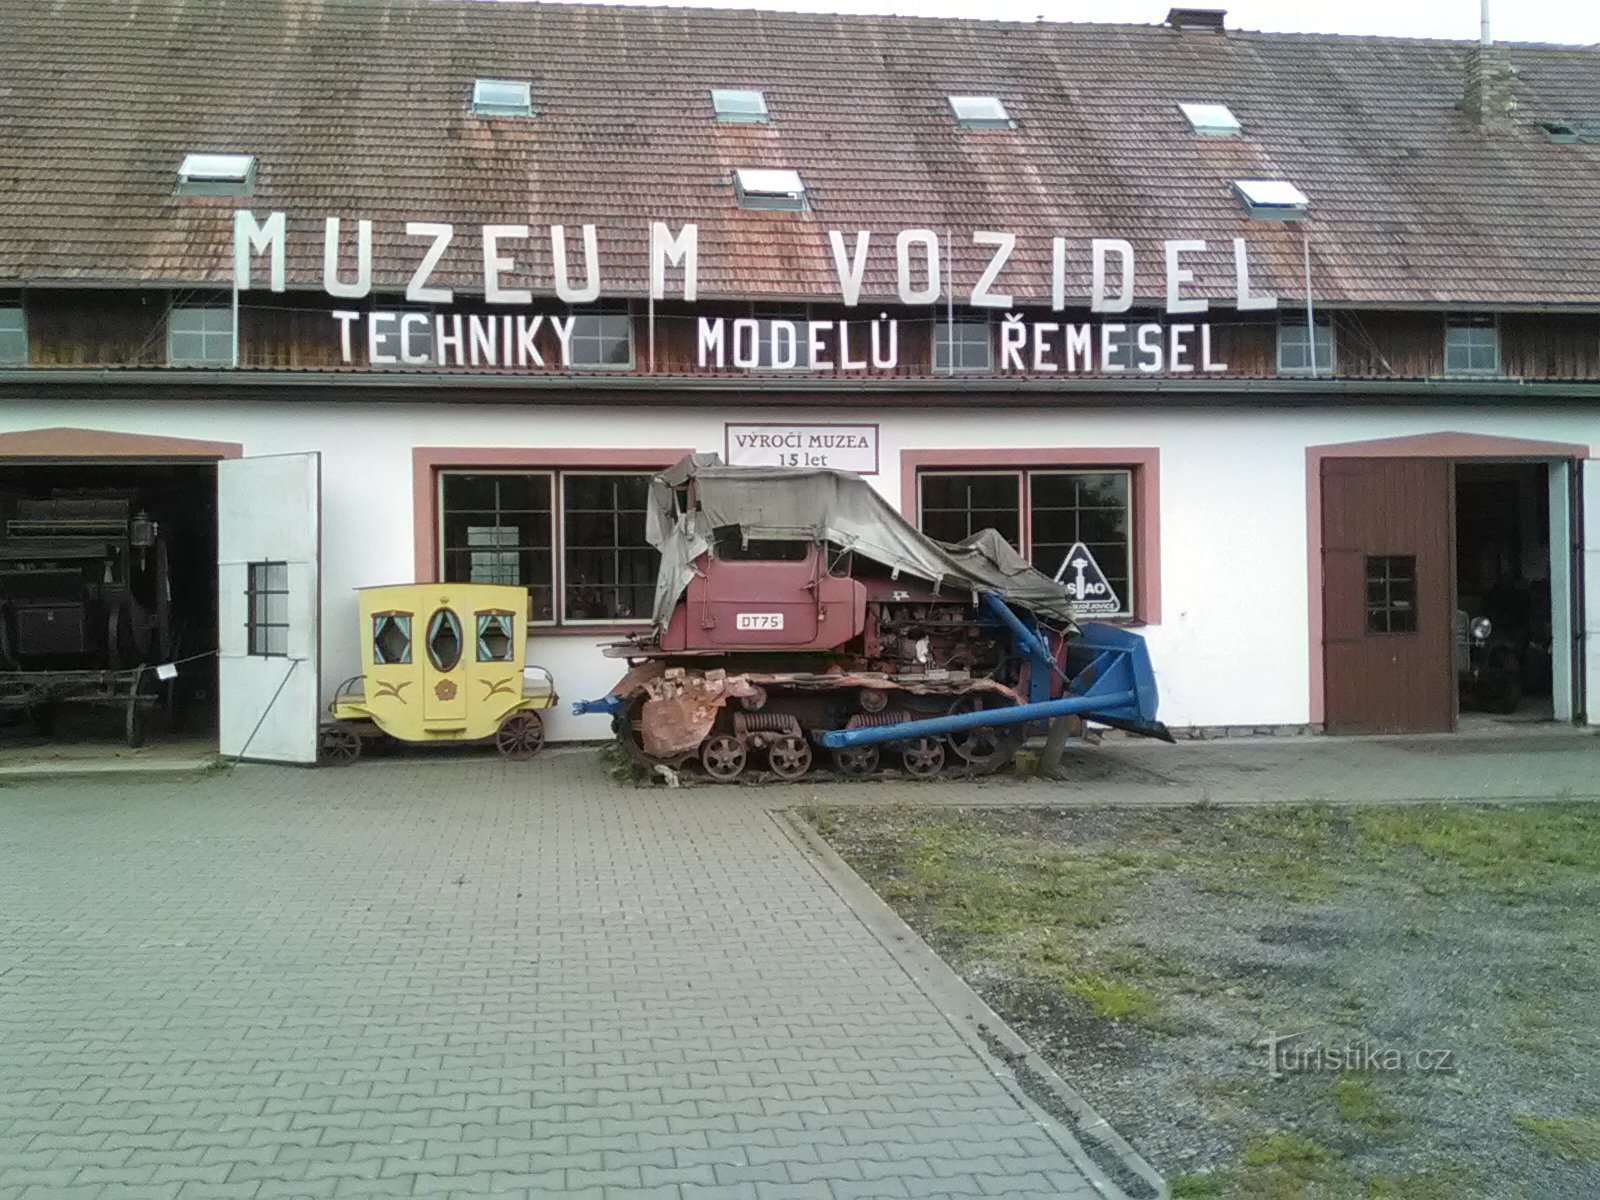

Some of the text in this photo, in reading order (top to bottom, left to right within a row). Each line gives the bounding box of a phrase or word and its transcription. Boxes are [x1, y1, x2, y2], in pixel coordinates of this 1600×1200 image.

[235, 211, 1278, 312] MUZEUM VOZIDEL
[333, 310, 1228, 372] TECHNIKY MODELŮ ŘEMESEL
[735, 431, 869, 448] VÝROČÍ MUZEA
[778, 452, 828, 467] 15 let
[741, 616, 780, 628] DT75
